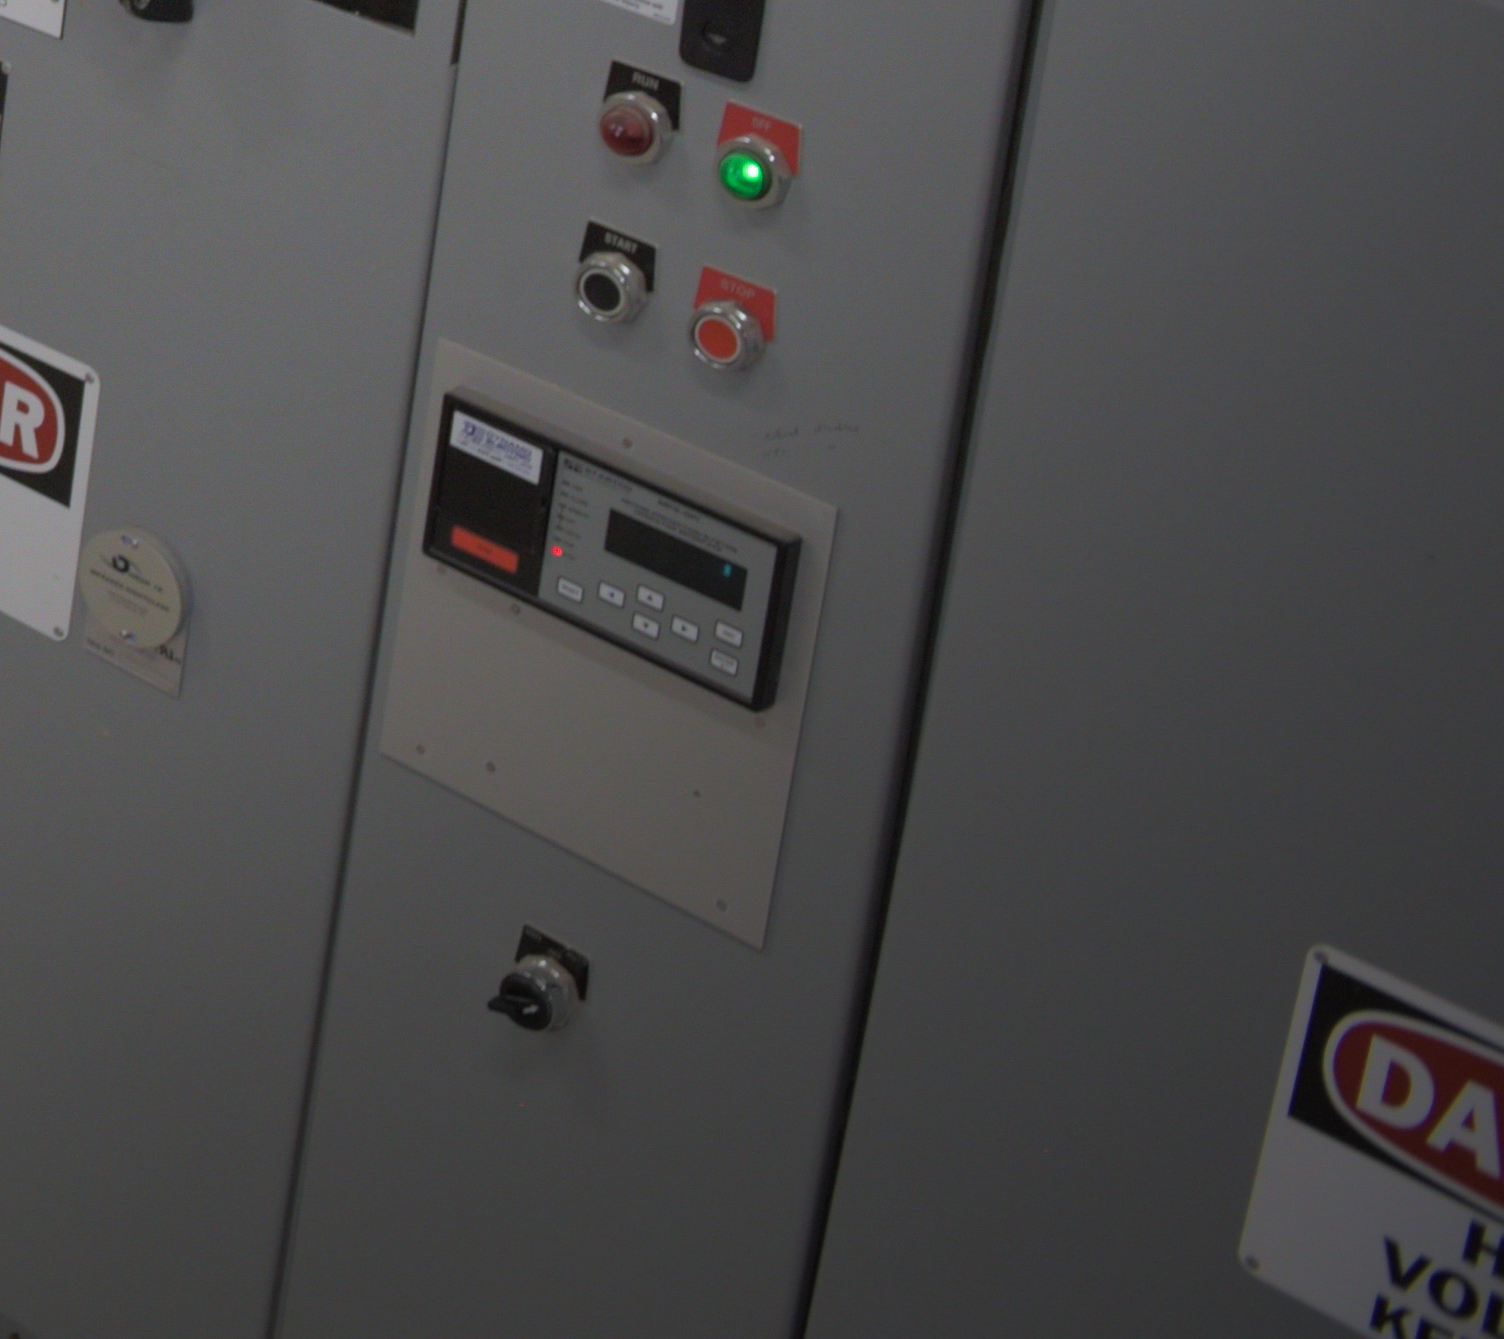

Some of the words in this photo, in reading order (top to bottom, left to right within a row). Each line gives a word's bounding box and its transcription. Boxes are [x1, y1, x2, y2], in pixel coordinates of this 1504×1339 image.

[632, 71, 659, 92] RUN
[603, 232, 638, 254] START
[720, 277, 756, 299] STOP
[1355, 1033, 1504, 1181] DA
